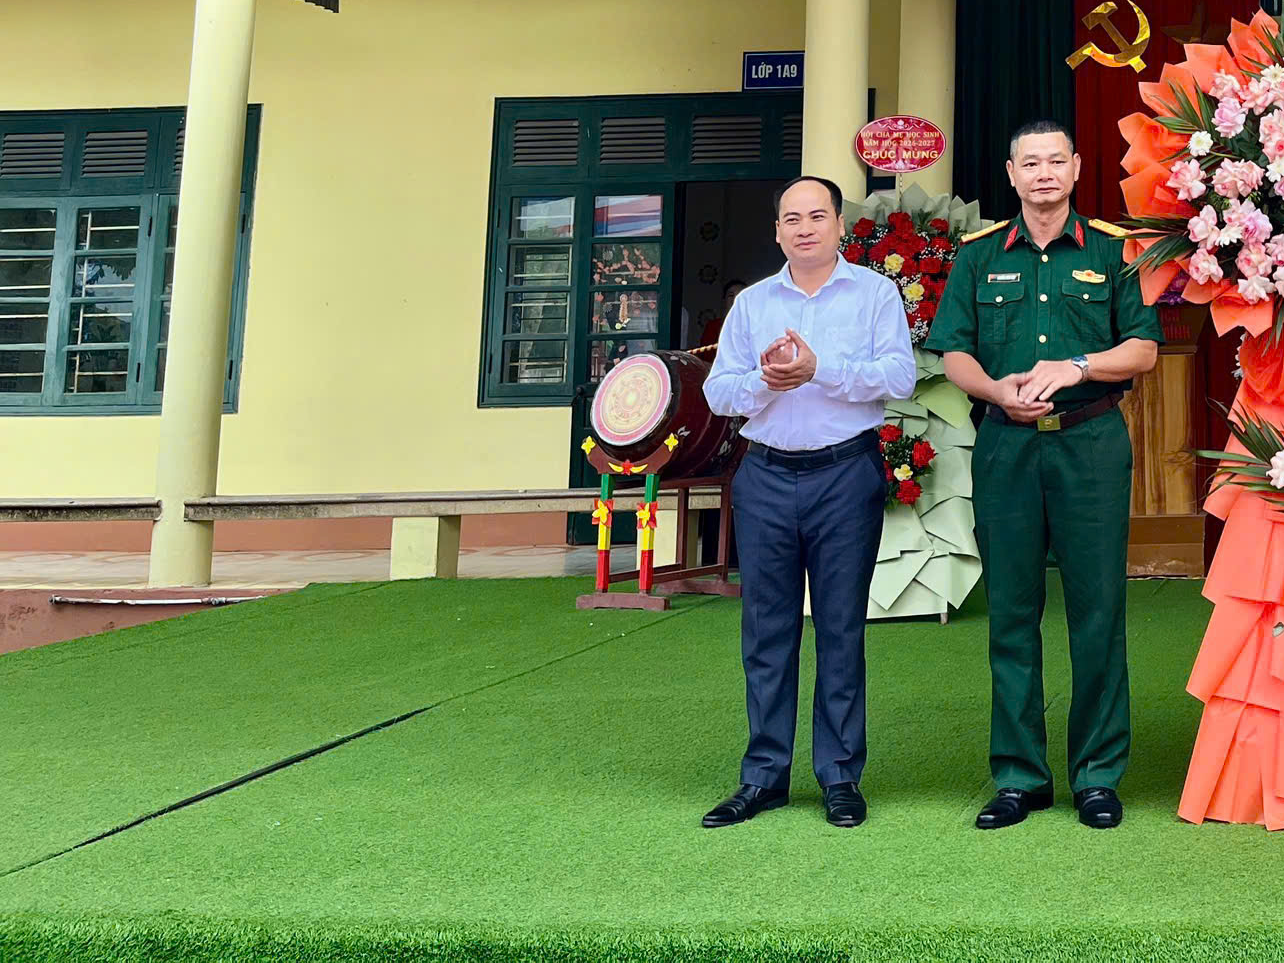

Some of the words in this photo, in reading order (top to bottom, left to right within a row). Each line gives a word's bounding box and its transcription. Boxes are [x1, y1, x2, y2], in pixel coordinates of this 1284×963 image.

[751, 62, 773, 79] LỚP
[776, 64, 798, 78] 1A9
[862, 148, 896, 159] CHÚC
